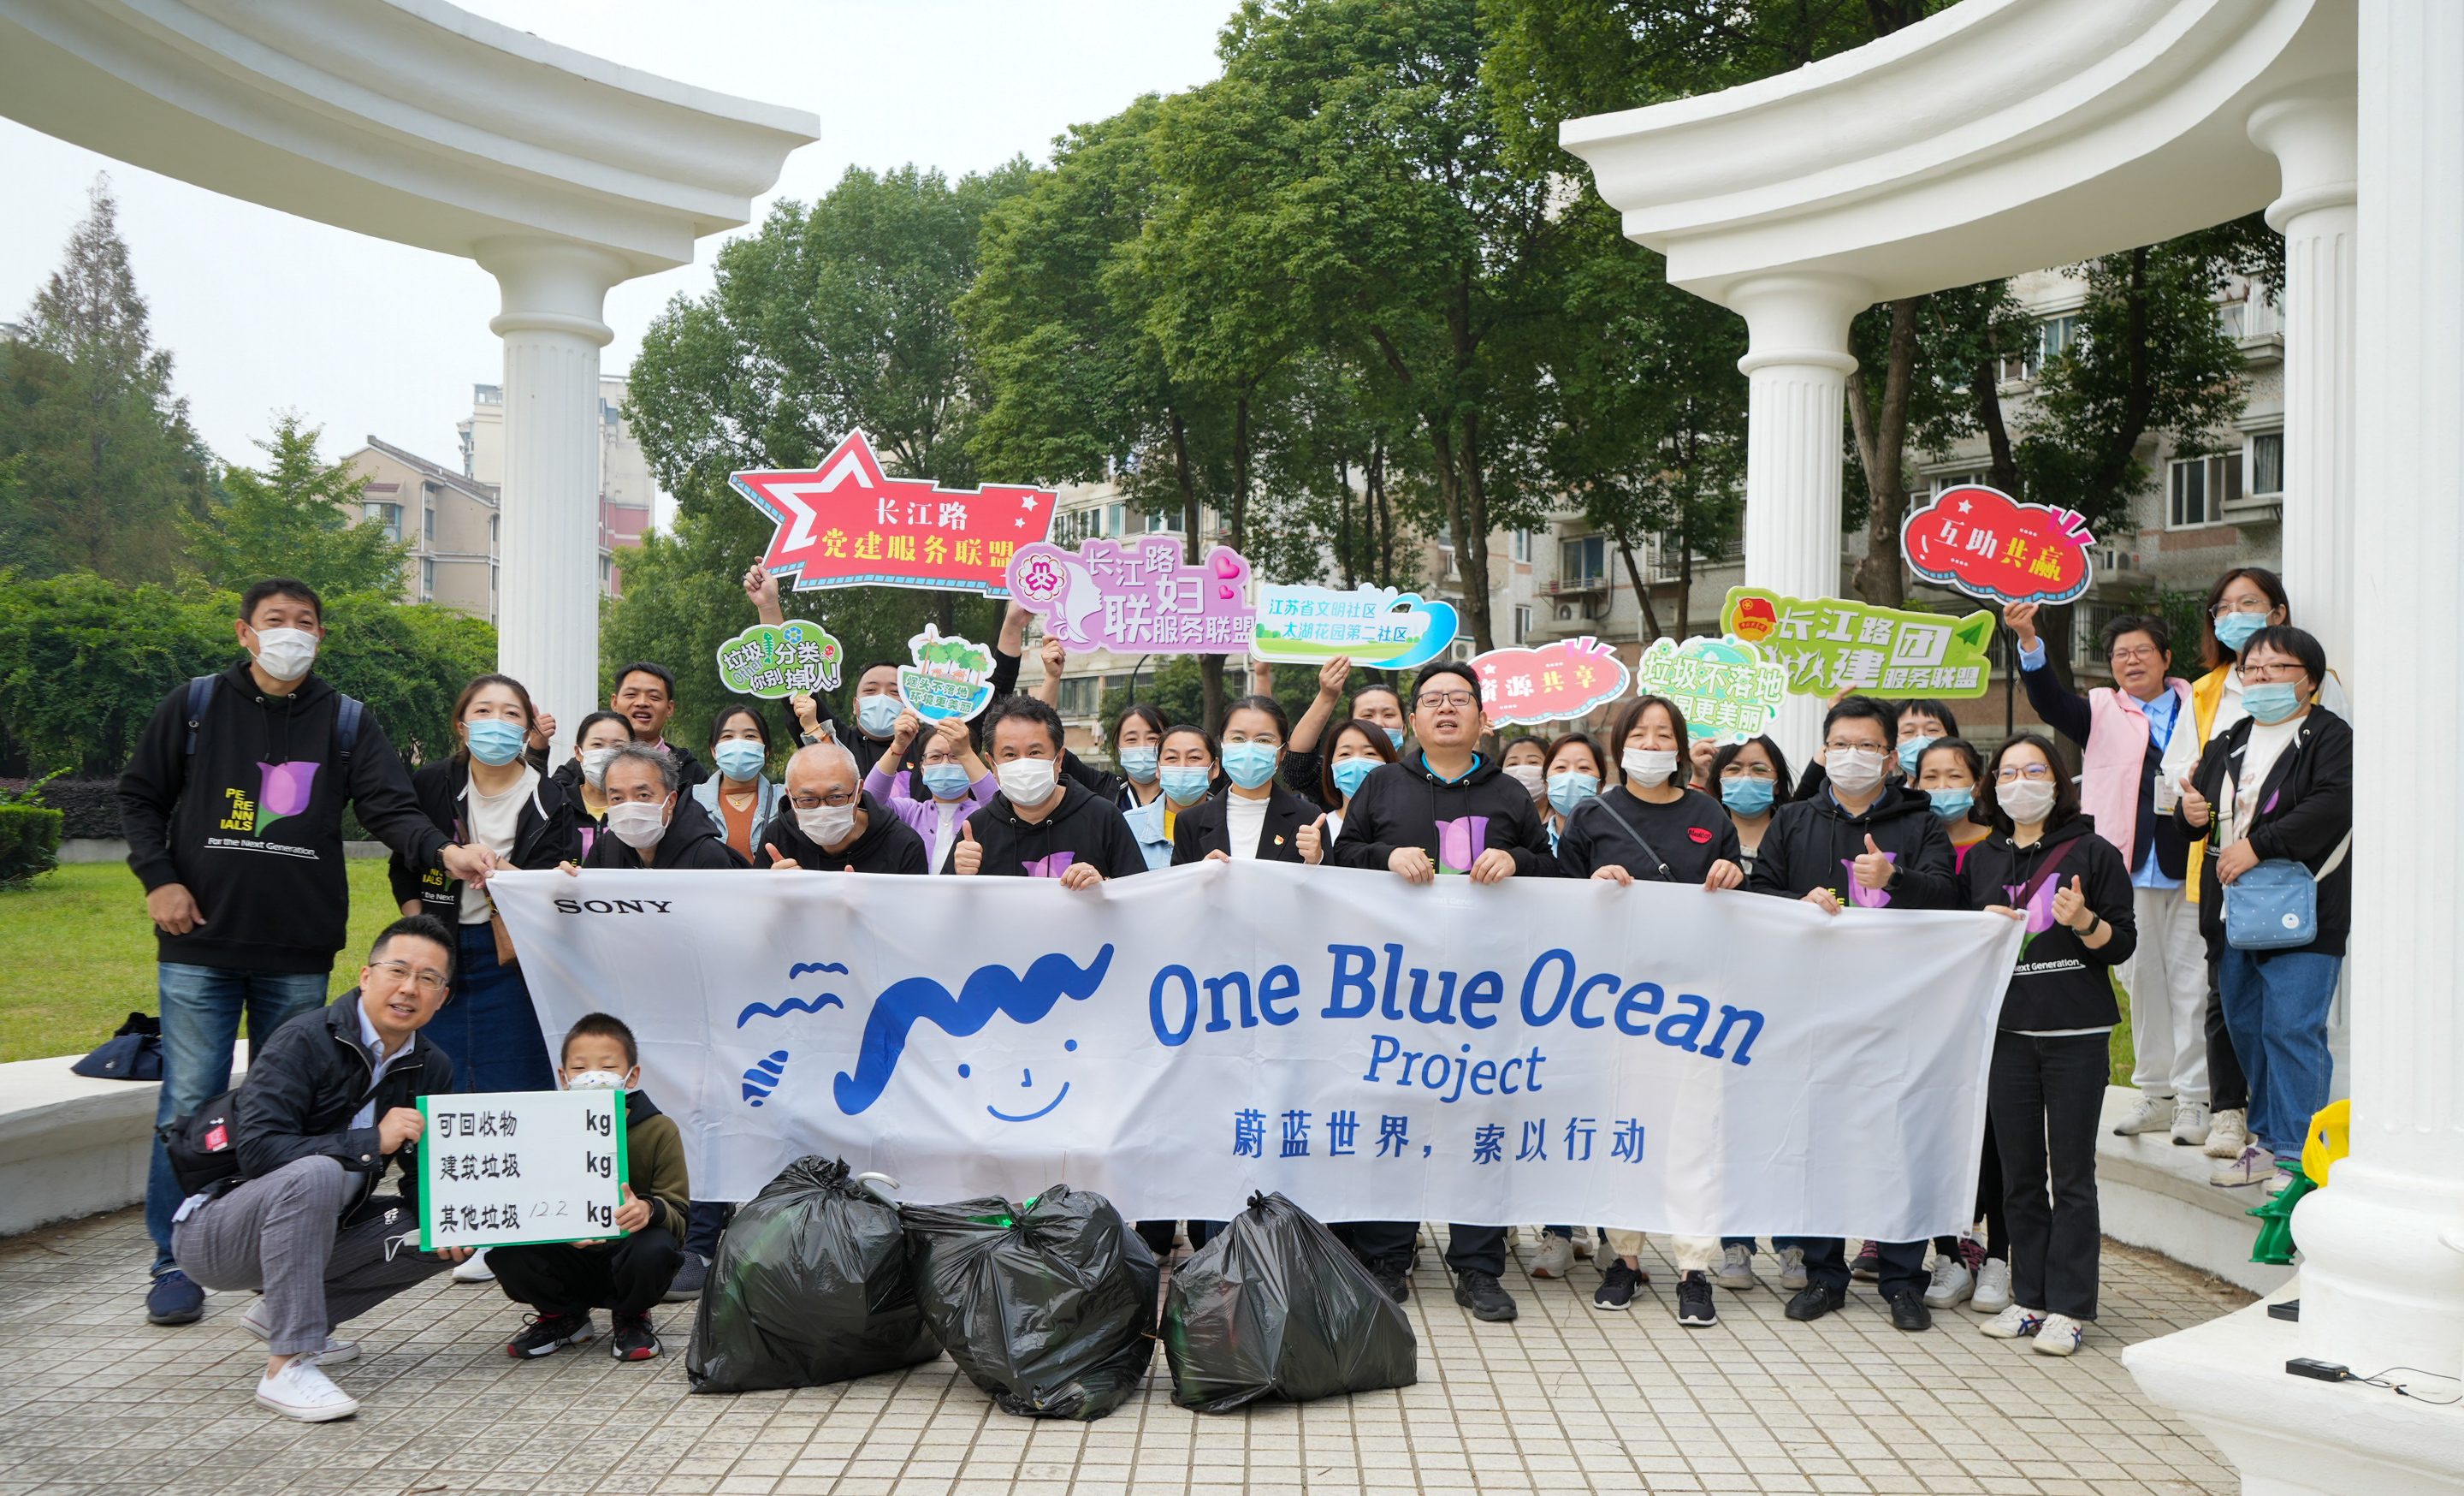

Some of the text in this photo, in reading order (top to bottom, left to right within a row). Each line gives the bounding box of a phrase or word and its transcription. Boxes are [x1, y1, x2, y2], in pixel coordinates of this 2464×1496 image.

[874, 497, 968, 531] 长江路
[821, 527, 1014, 568] 党建服务联盟
[1934, 517, 2064, 582] 互助共赢
[1086, 545, 1176, 587] 长江路
[1269, 599, 1377, 618] 江苏省文明社区
[1282, 622, 1408, 642] 太湖花园第二社区
[732, 659, 763, 685] Other
[1481, 665, 1596, 703] 资源共享
[1643, 652, 1785, 703] 垃圾不落地
[906, 675, 968, 698] 烟头不落地
[909, 691, 973, 713] 环境更美丽
[1652, 690, 1764, 732] 园更美丽
[225, 788, 246, 800] PE
[233, 799, 254, 810] RE
[220, 819, 253, 831] IALS
[231, 810, 255, 822] NN
[208, 837, 222, 846] For
[240, 840, 265, 849] Next
[265, 842, 315, 855] Generation
[422, 874, 443, 886] IALS
[554, 899, 672, 915] SONY
[2031, 959, 2080, 971] Generation
[1149, 943, 1765, 1066] One Blue Ocean
[1363, 1035, 1547, 1103] Project
[437, 1110, 518, 1138] 可回收物
[586, 1109, 611, 1137] kg
[440, 1152, 521, 1182] 建筑垃圾
[586, 1151, 611, 1178] kg
[440, 1203, 521, 1233] 其他垃圾
[529, 1200, 569, 1219] 12.2
[587, 1200, 612, 1228] kg
